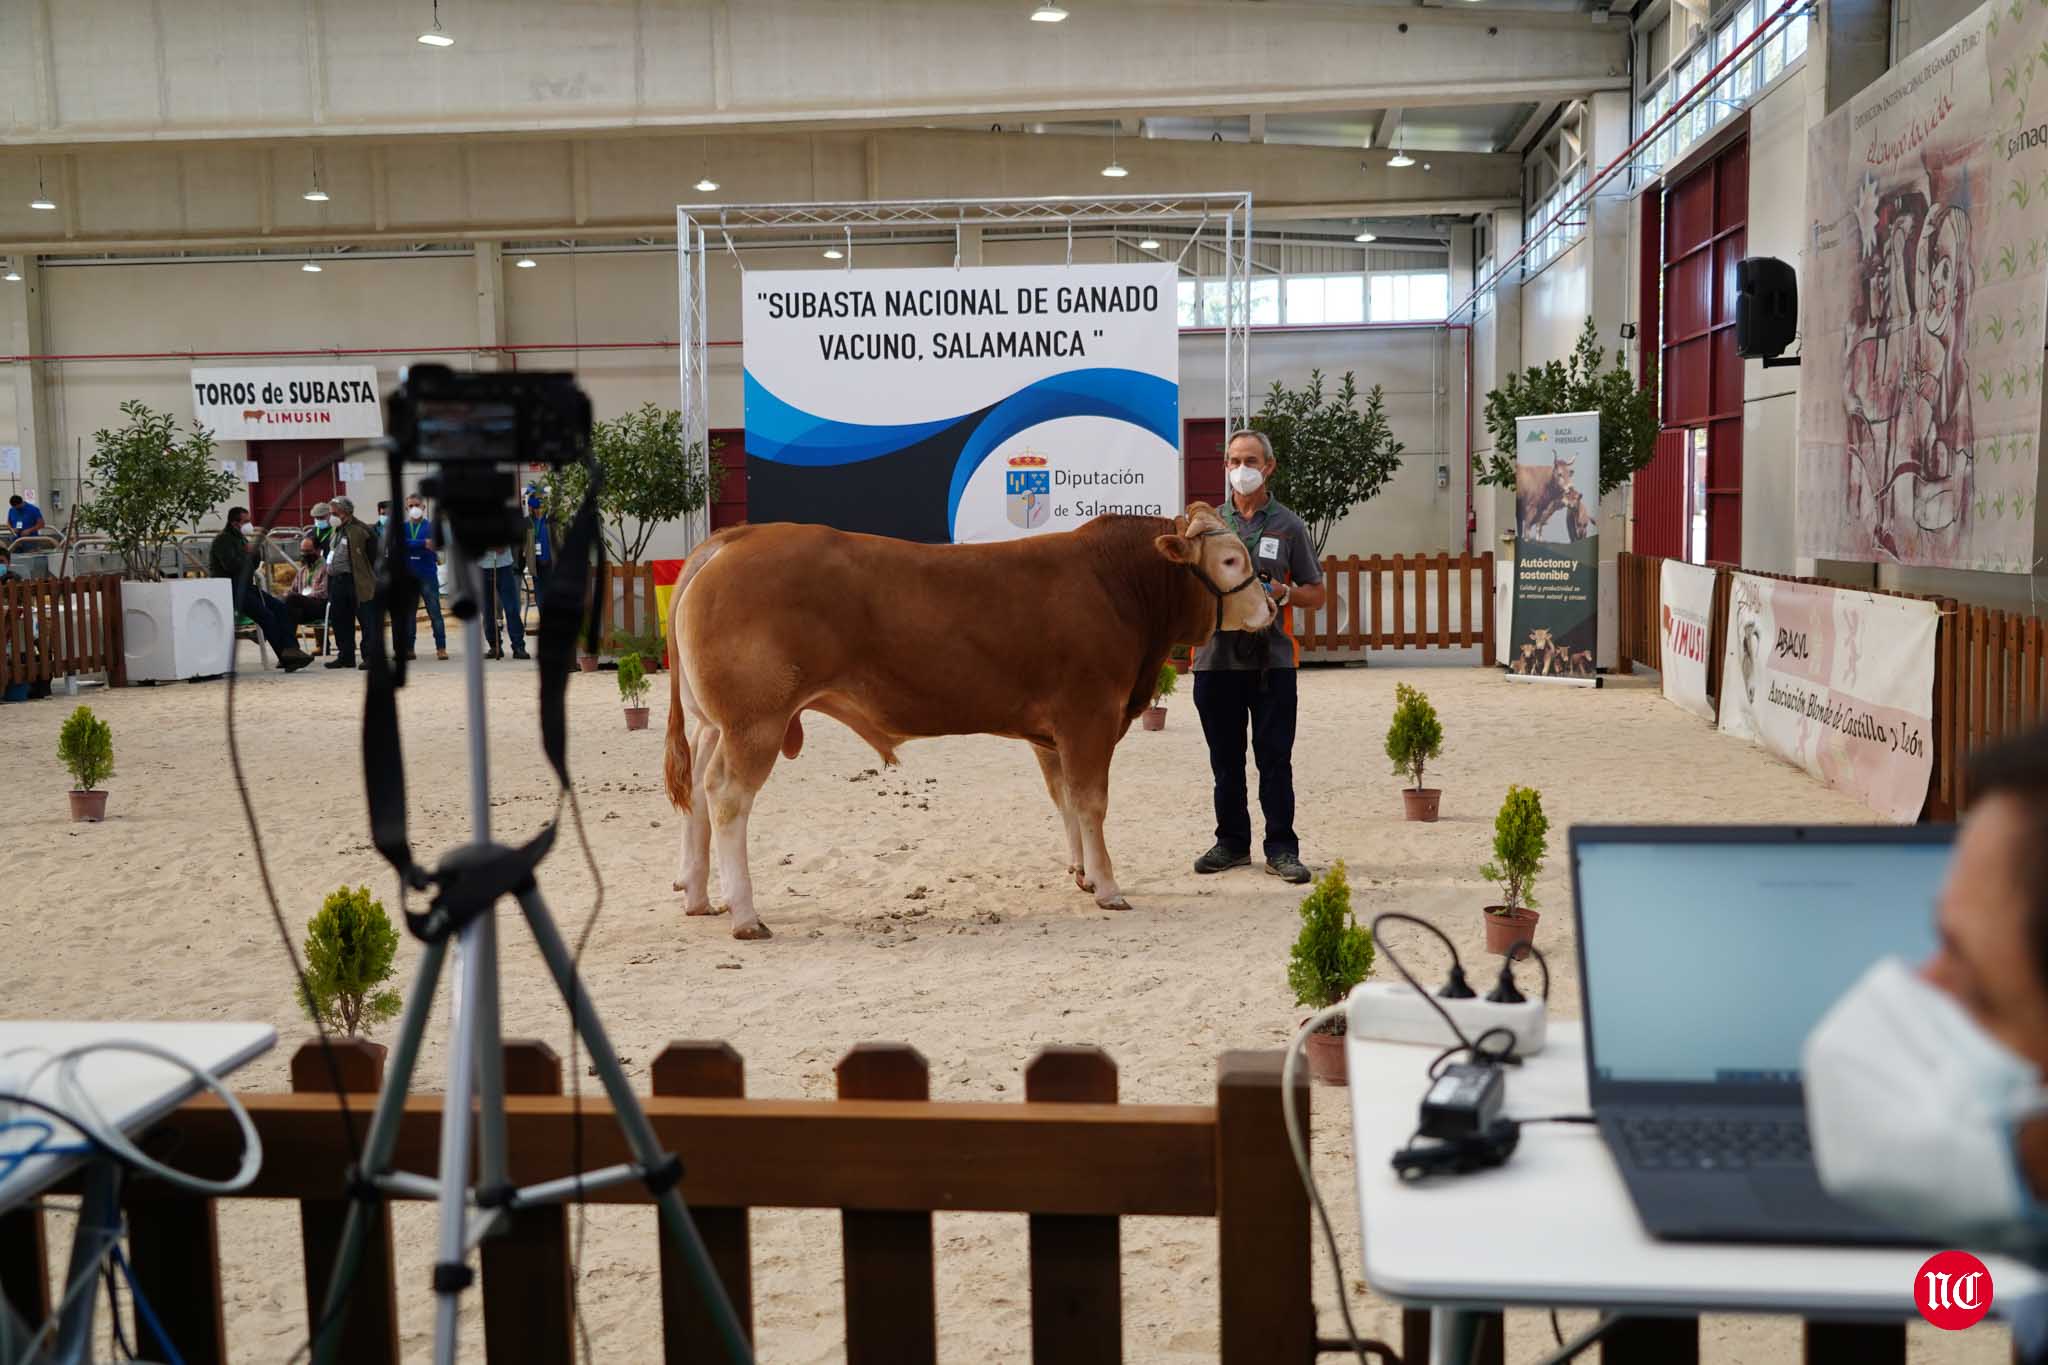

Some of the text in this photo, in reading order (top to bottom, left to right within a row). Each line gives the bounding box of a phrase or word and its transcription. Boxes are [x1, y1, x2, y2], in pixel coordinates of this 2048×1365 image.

[757, 285, 1158, 319] "SUBASTA NACIONAL DE GANADO
[819, 333, 924, 361] VACUNO,
[932, 330, 1085, 359] SALAMANCA
[195, 381, 376, 406] TOROS de SUBASTA
[267, 411, 331, 424] LIMUSIN
[1055, 469, 1144, 488] Diputación
[1054, 500, 1162, 517] de Salamanca
[1520, 557, 1578, 572] Autóctona y
[1520, 570, 1569, 580] sostenible
[1768, 680, 1923, 759] Asociación Blonde de Castilla y León
